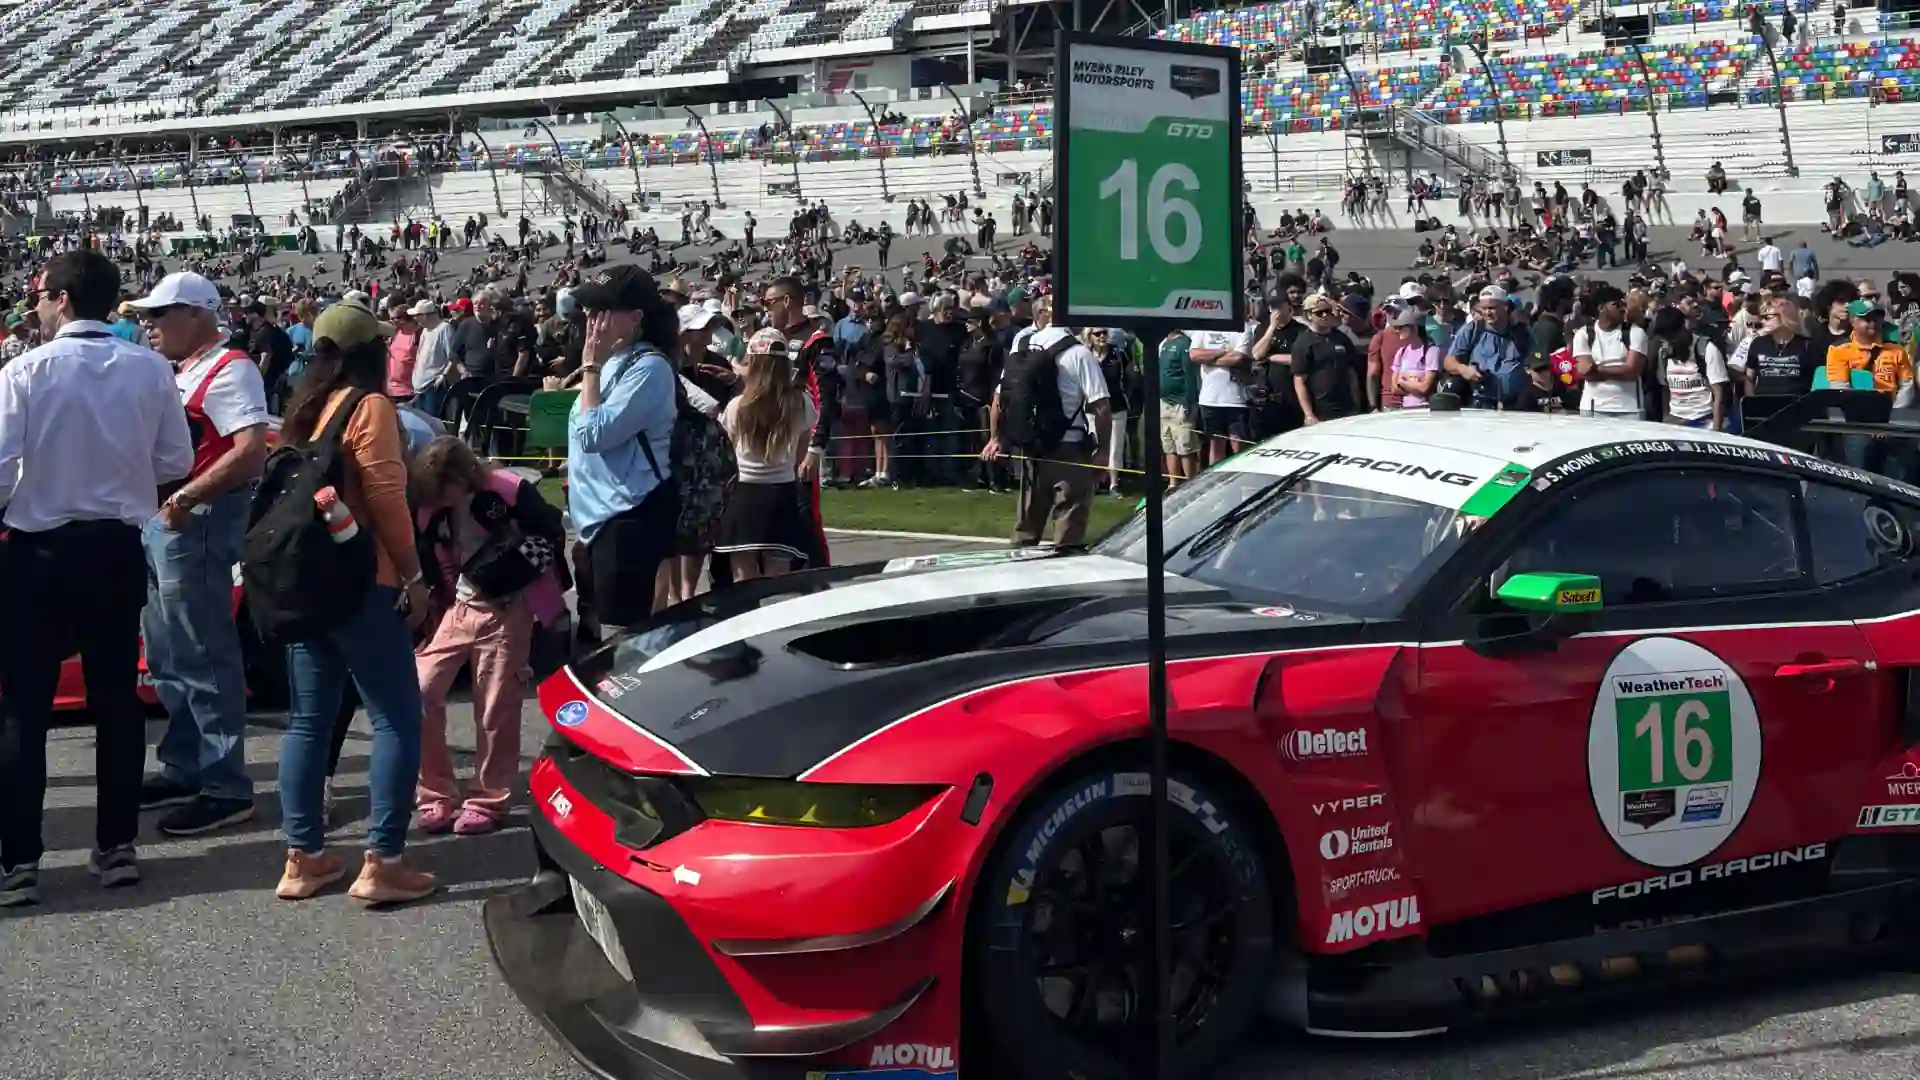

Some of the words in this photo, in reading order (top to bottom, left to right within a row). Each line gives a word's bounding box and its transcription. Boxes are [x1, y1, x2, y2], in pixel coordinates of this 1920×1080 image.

[1073, 72, 1155, 90] MOTORSPORTS
[1115, 64, 1145, 76] RILEY
[1167, 122, 1213, 139] GTD
[1099, 157, 1203, 264] 16
[1190, 299, 1224, 310] IMSA
[1615, 444, 1628, 456] F.
[1627, 441, 1674, 456] FRAGA
[1695, 442, 1706, 453] J.
[1707, 443, 1771, 462] ALTZMAN
[1246, 448, 1321, 461] FORD
[1329, 453, 1478, 487] RACING
[1546, 471, 1563, 483] S.
[1557, 452, 1600, 476] MONK
[1791, 456, 1805, 468] R.
[1806, 461, 1874, 485] GROSJEAN
[1618, 675, 1723, 694] WeatherTech
[1297, 727, 1367, 755] DeTect
[1635, 700, 1713, 783] 16
[1312, 794, 1384, 816] VYPER
[1025, 780, 1106, 866] MICHELIN
[1351, 822, 1389, 841] United
[1351, 837, 1393, 854] Rentals
[1592, 870, 1692, 905] FORD
[1700, 842, 1827, 882] RACING
[1325, 895, 1421, 944] MOTUL
[869, 1043, 954, 1069] MOTUL
